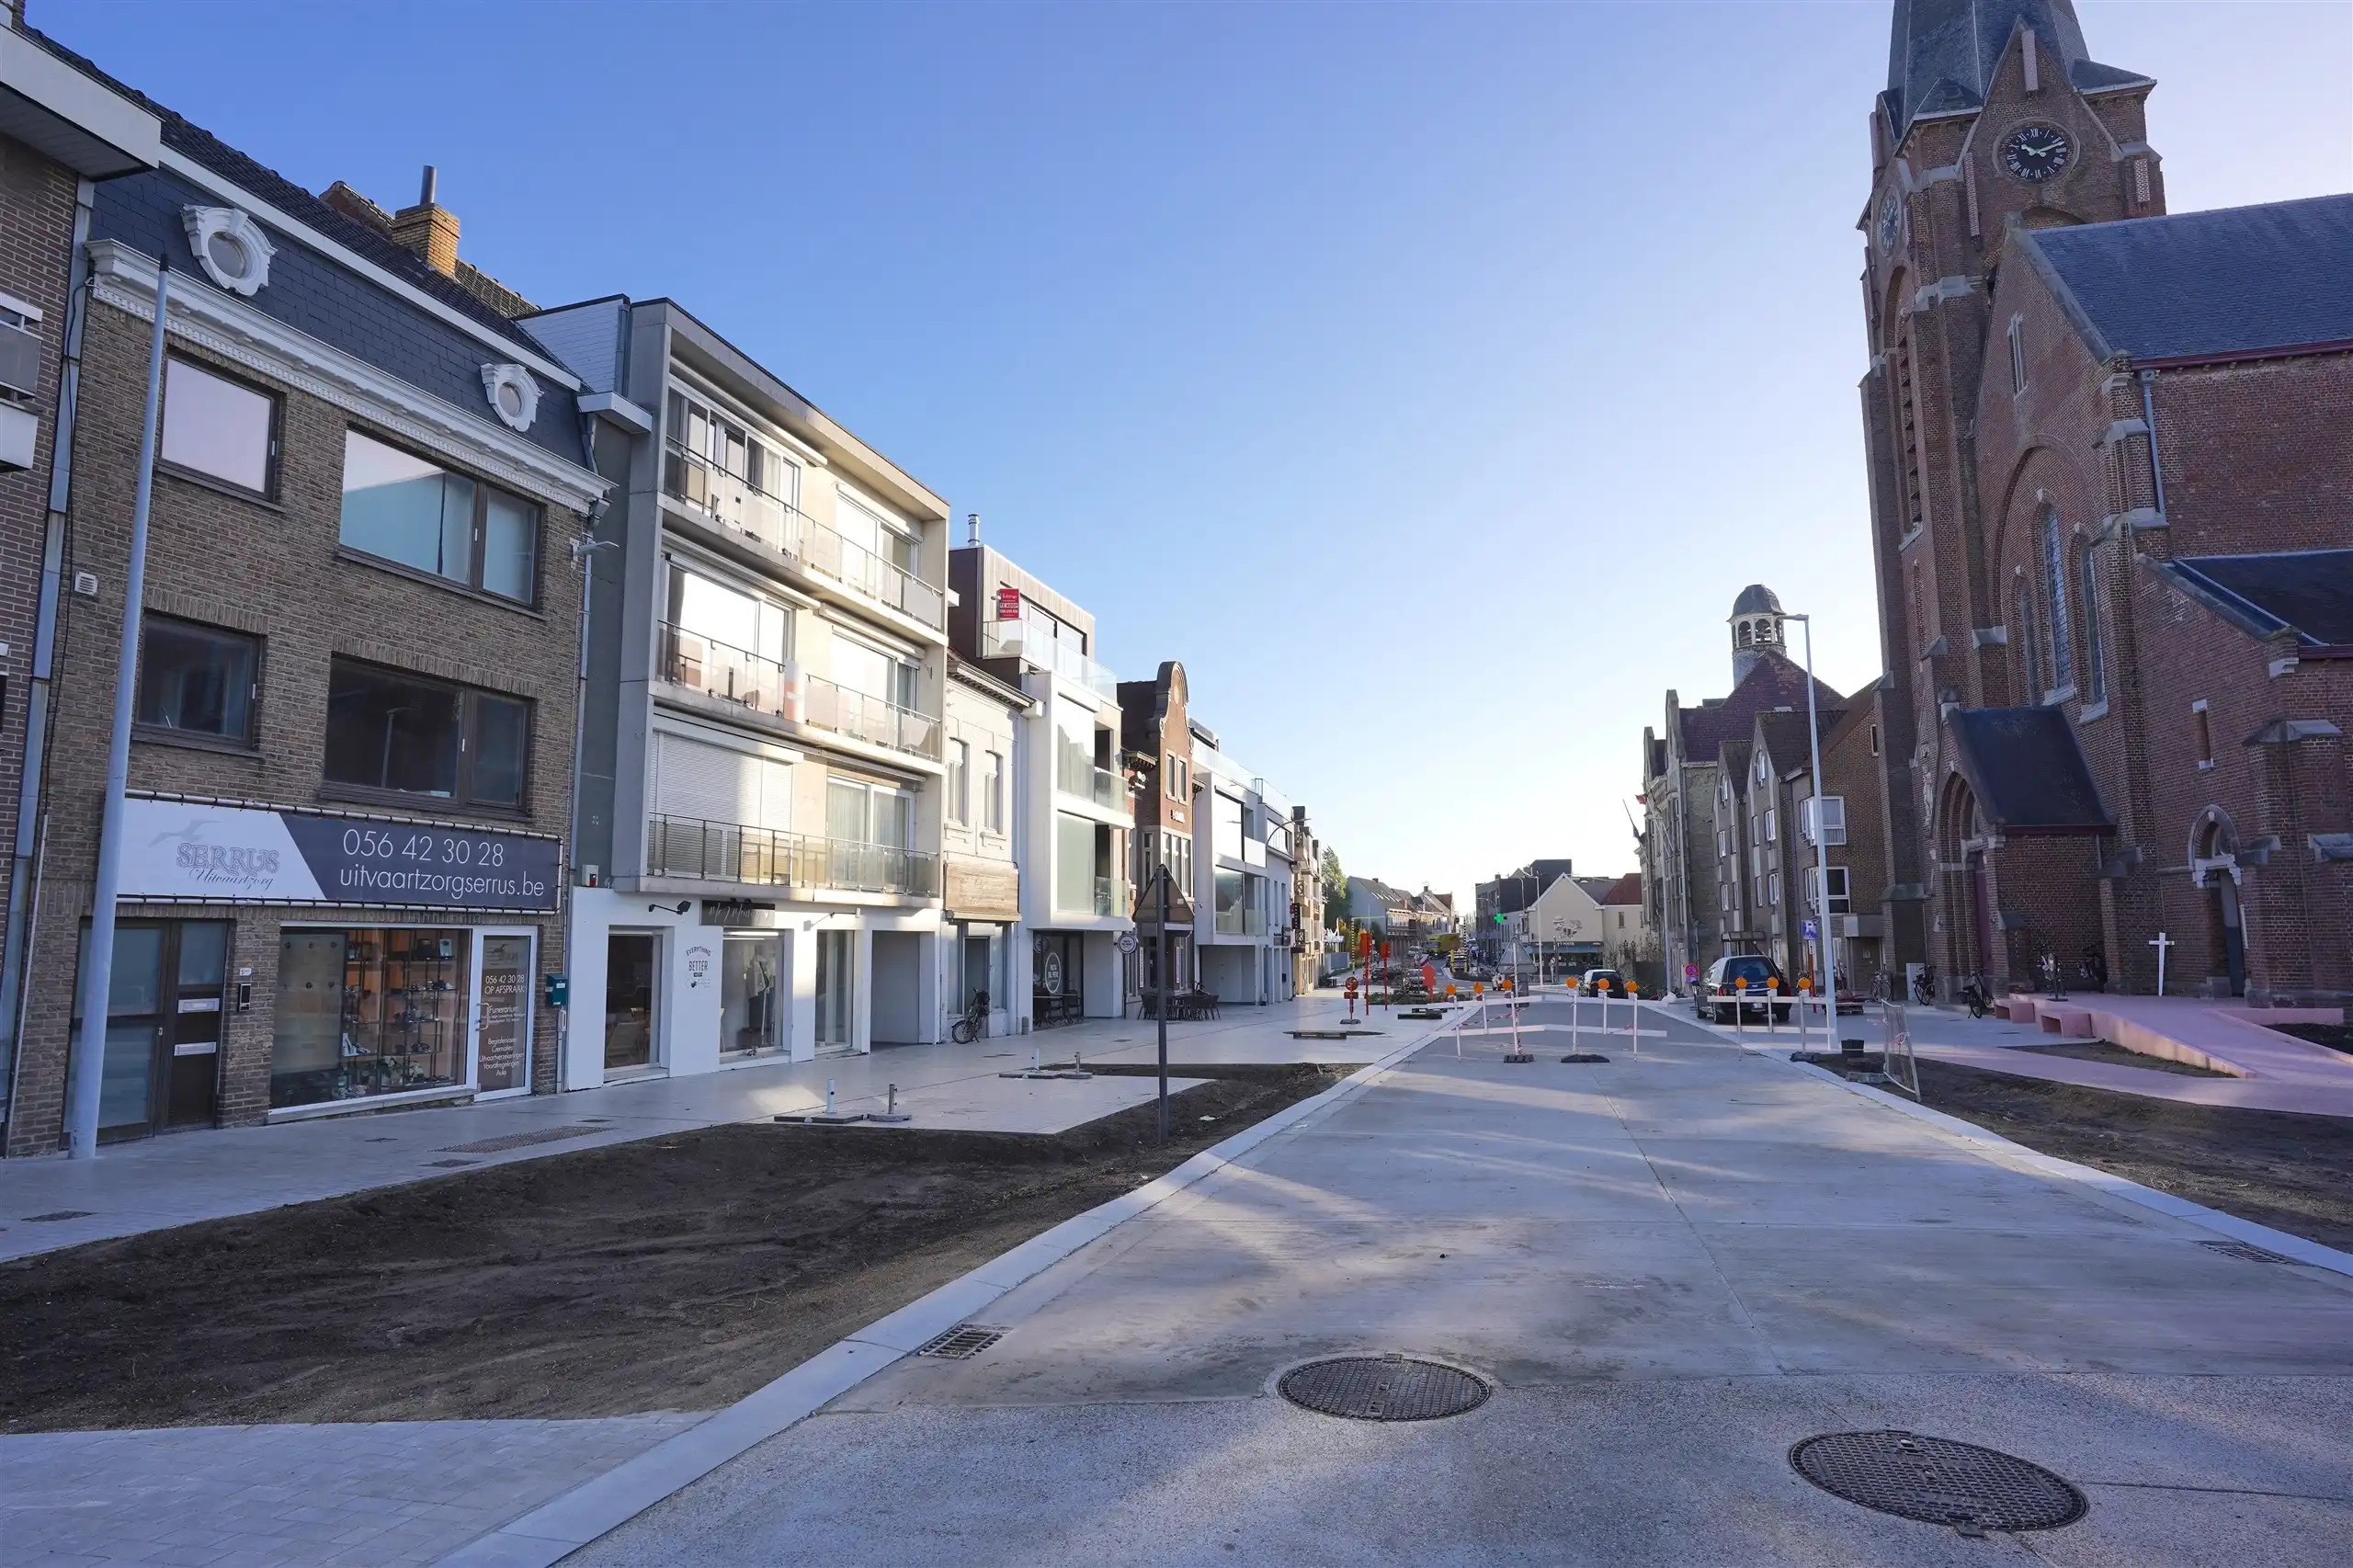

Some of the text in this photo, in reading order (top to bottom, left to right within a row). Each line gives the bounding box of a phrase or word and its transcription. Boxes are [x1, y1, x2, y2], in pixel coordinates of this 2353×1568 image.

[176, 842, 279, 877] SERRUS
[344, 829, 504, 867] 056 42 30 28
[189, 868, 274, 892] Uitvaartzorg
[340, 863, 544, 900] uitvaartzorgserrus.be
[688, 960, 709, 971] BETTER
[484, 984, 525, 994] OP AFSPRAAK
[485, 974, 525, 984] 056 42 30 28
